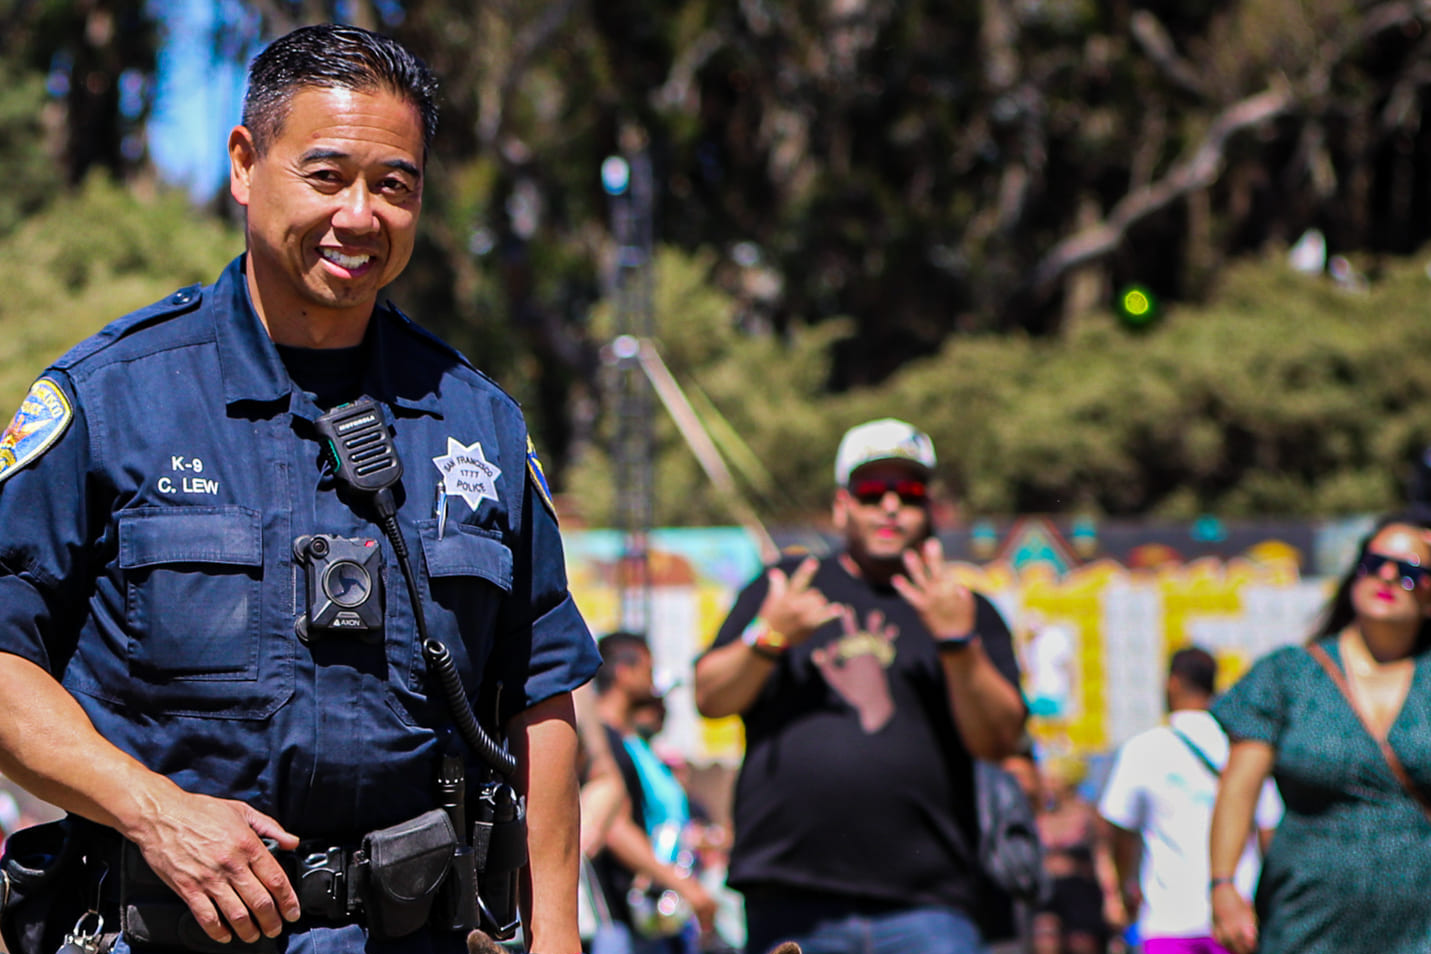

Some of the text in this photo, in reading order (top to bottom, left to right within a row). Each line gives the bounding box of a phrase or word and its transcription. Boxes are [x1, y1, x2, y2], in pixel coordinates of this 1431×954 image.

[171, 455, 203, 473] K-9
[157, 477, 219, 495] C. LEW
[456, 479, 486, 494] POLICE
